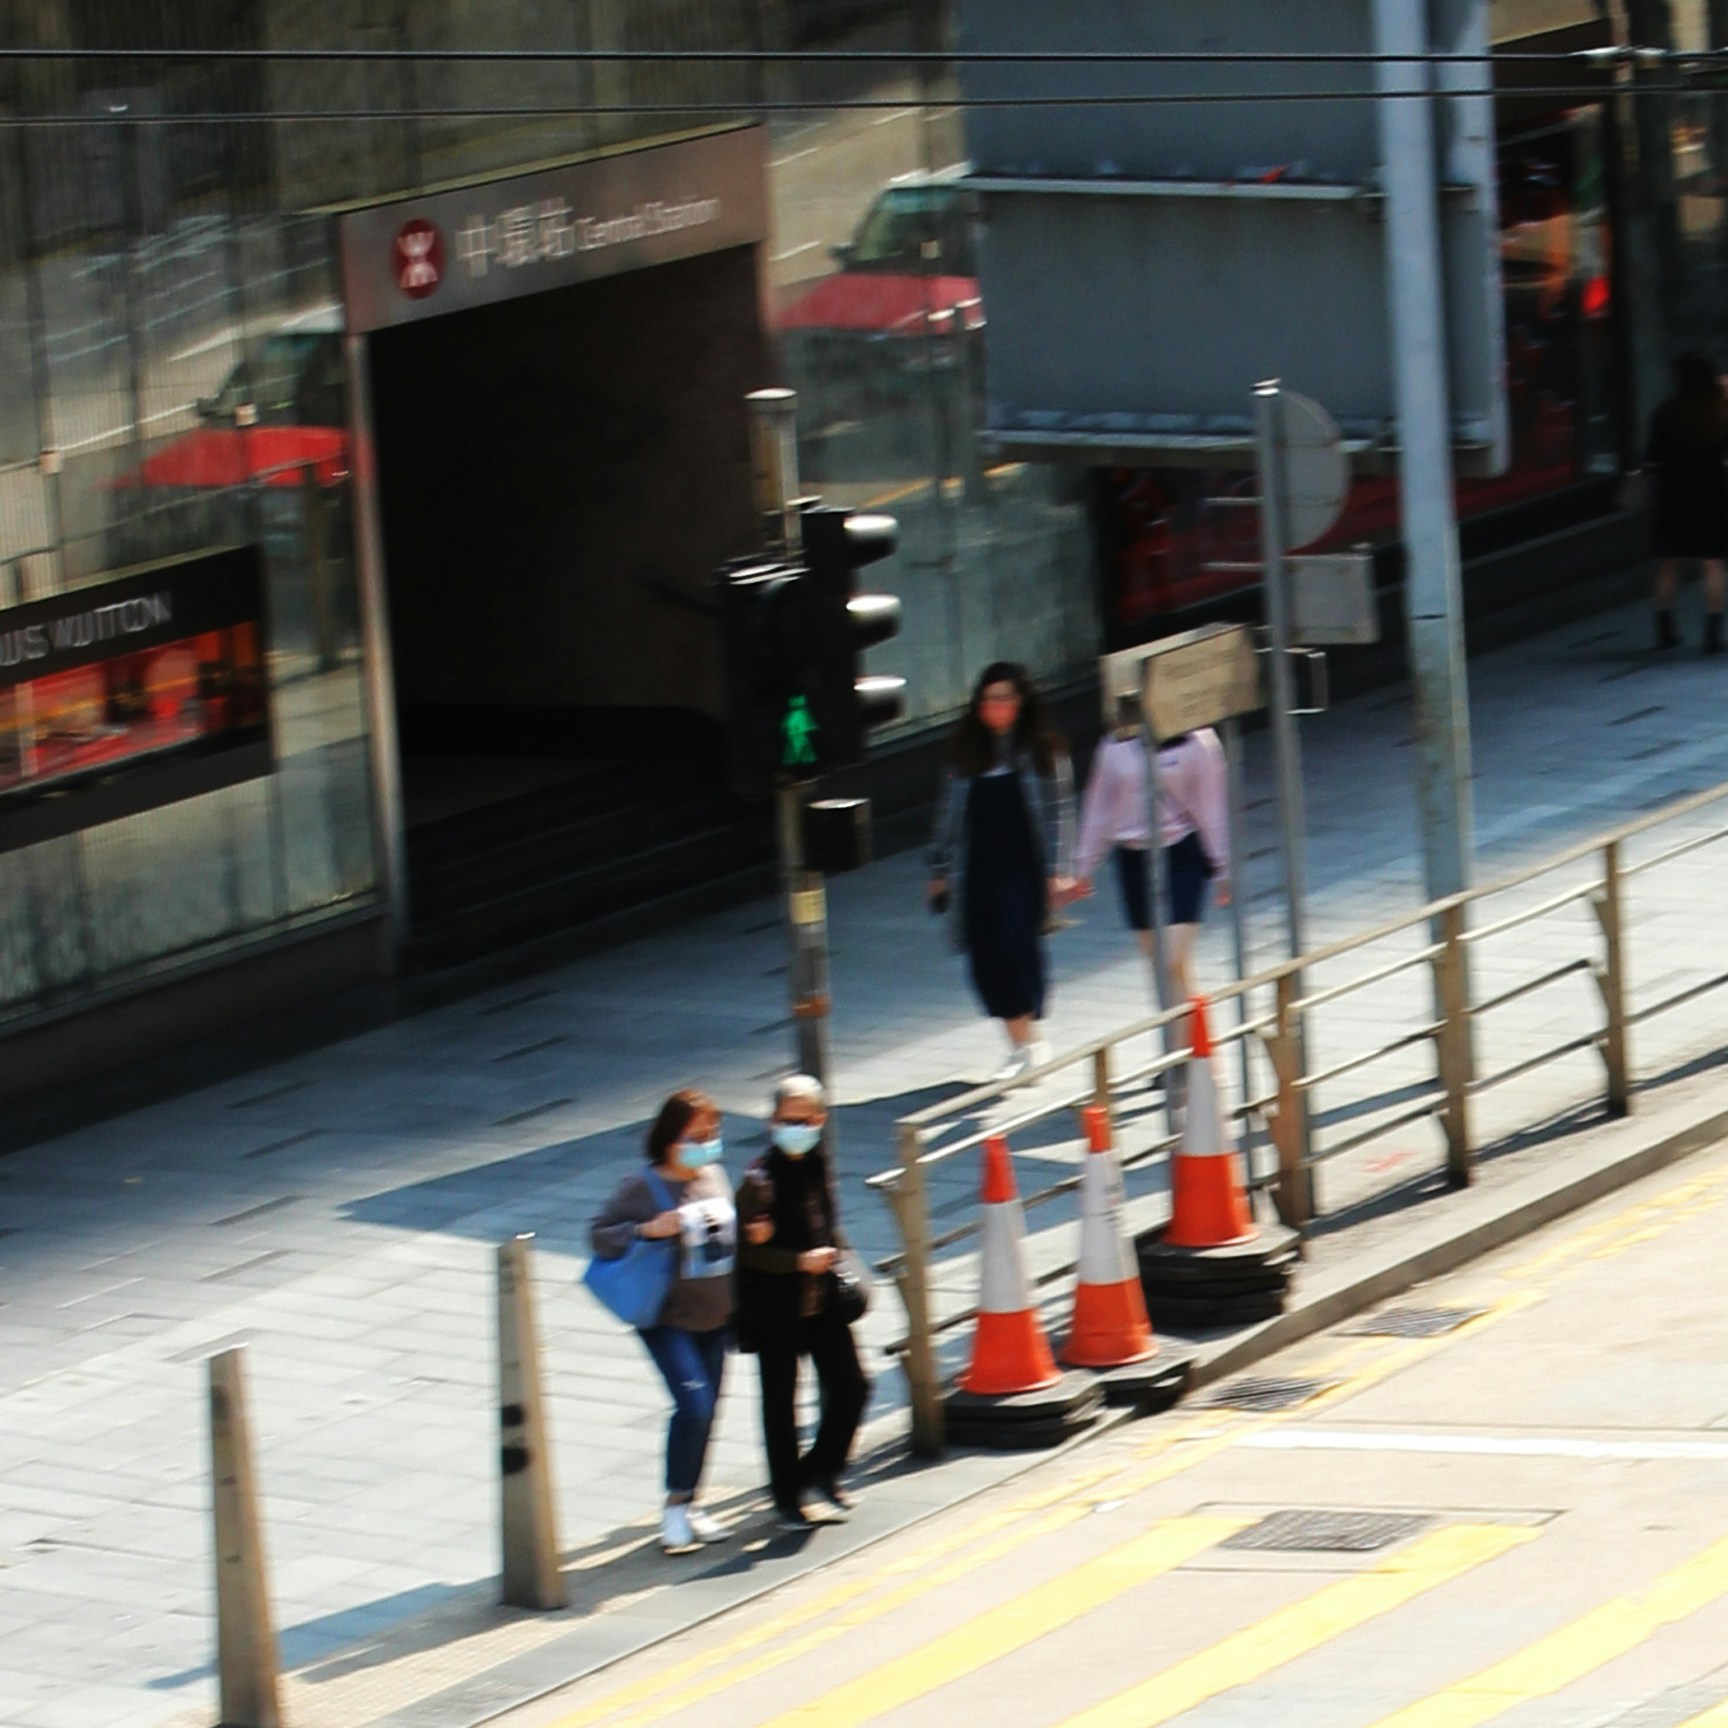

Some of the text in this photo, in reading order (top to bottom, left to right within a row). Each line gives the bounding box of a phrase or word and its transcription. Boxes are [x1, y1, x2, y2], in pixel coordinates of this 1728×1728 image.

[574, 195, 721, 251] Central Station
[54, 592, 173, 649] VUITTON
